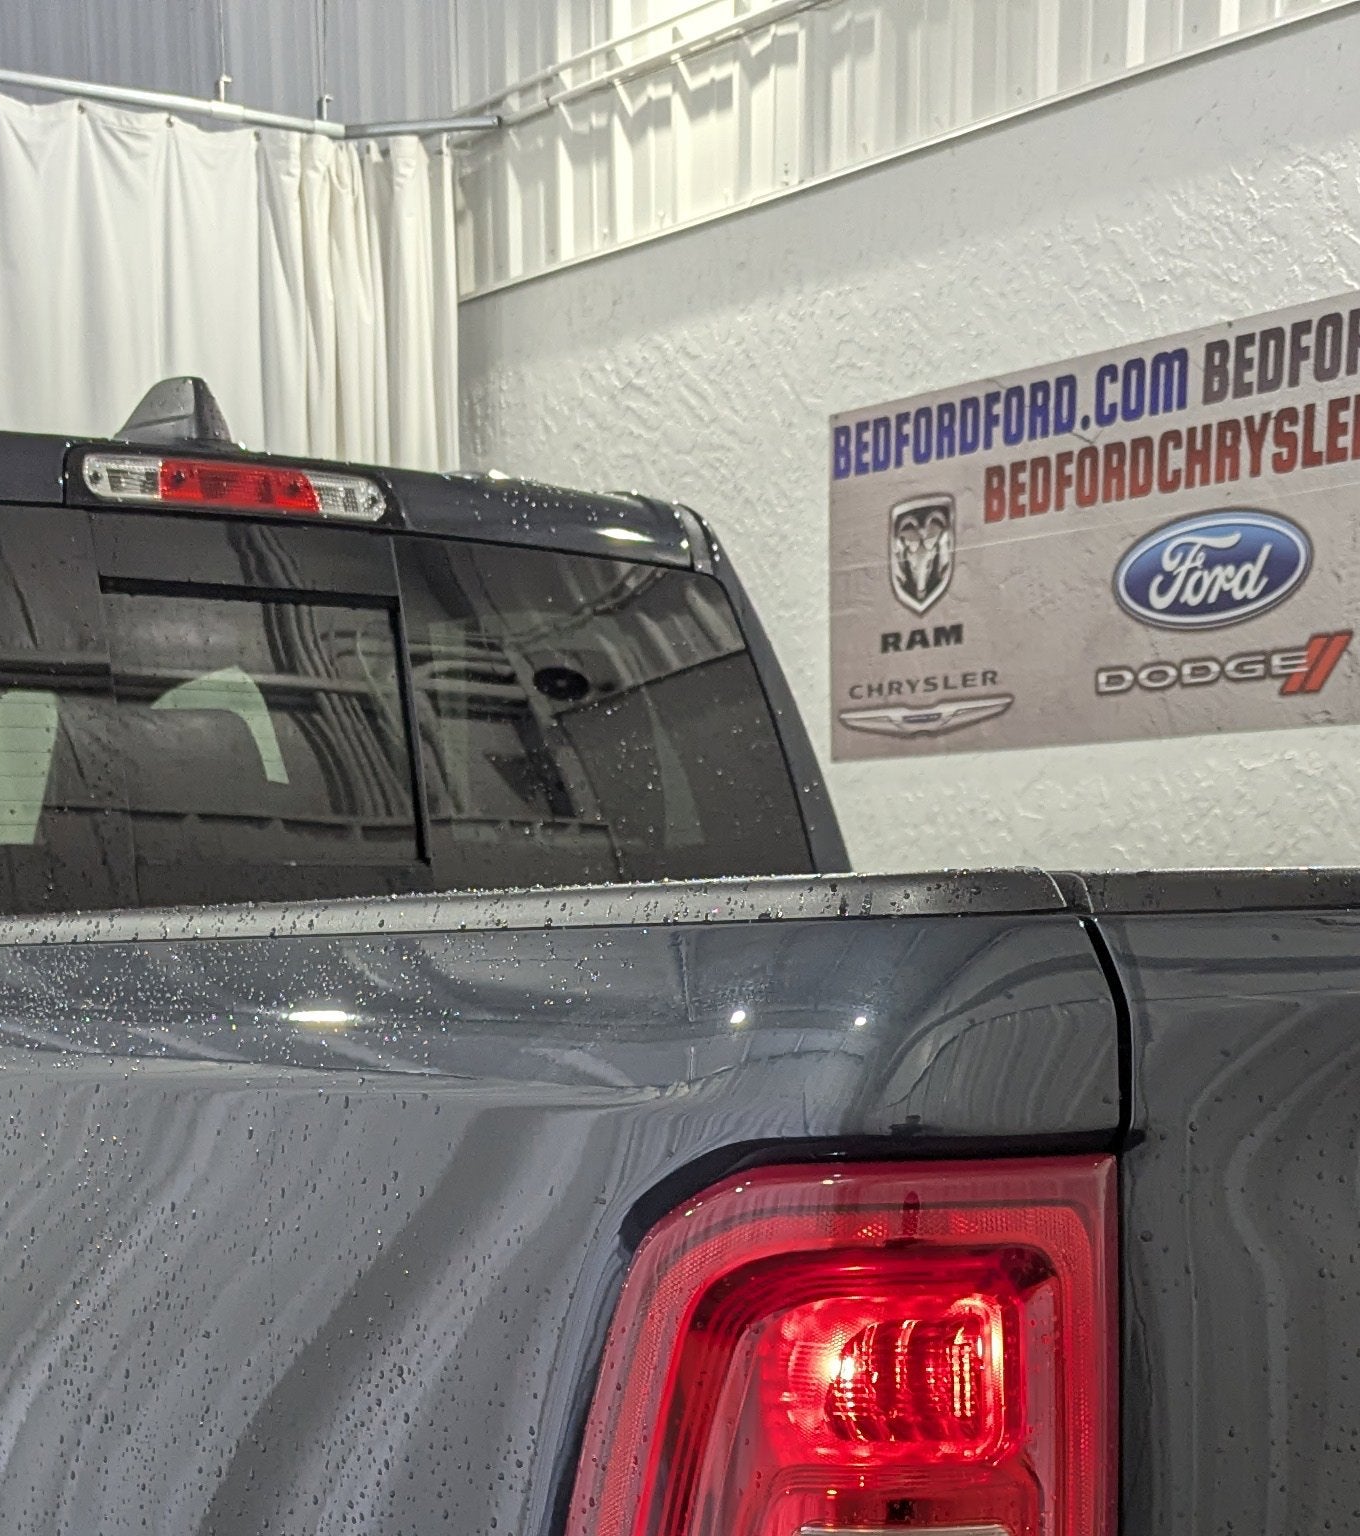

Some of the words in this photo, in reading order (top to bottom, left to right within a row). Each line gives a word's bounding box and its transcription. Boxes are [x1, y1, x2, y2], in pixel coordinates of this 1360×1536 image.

[833, 347, 1189, 480] BEDFORDFORD.COM
[1148, 531, 1273, 610] Ford
[880, 623, 964, 654] RAM
[848, 669, 998, 700] CHRYSLER
[1095, 648, 1312, 695] DODGE
